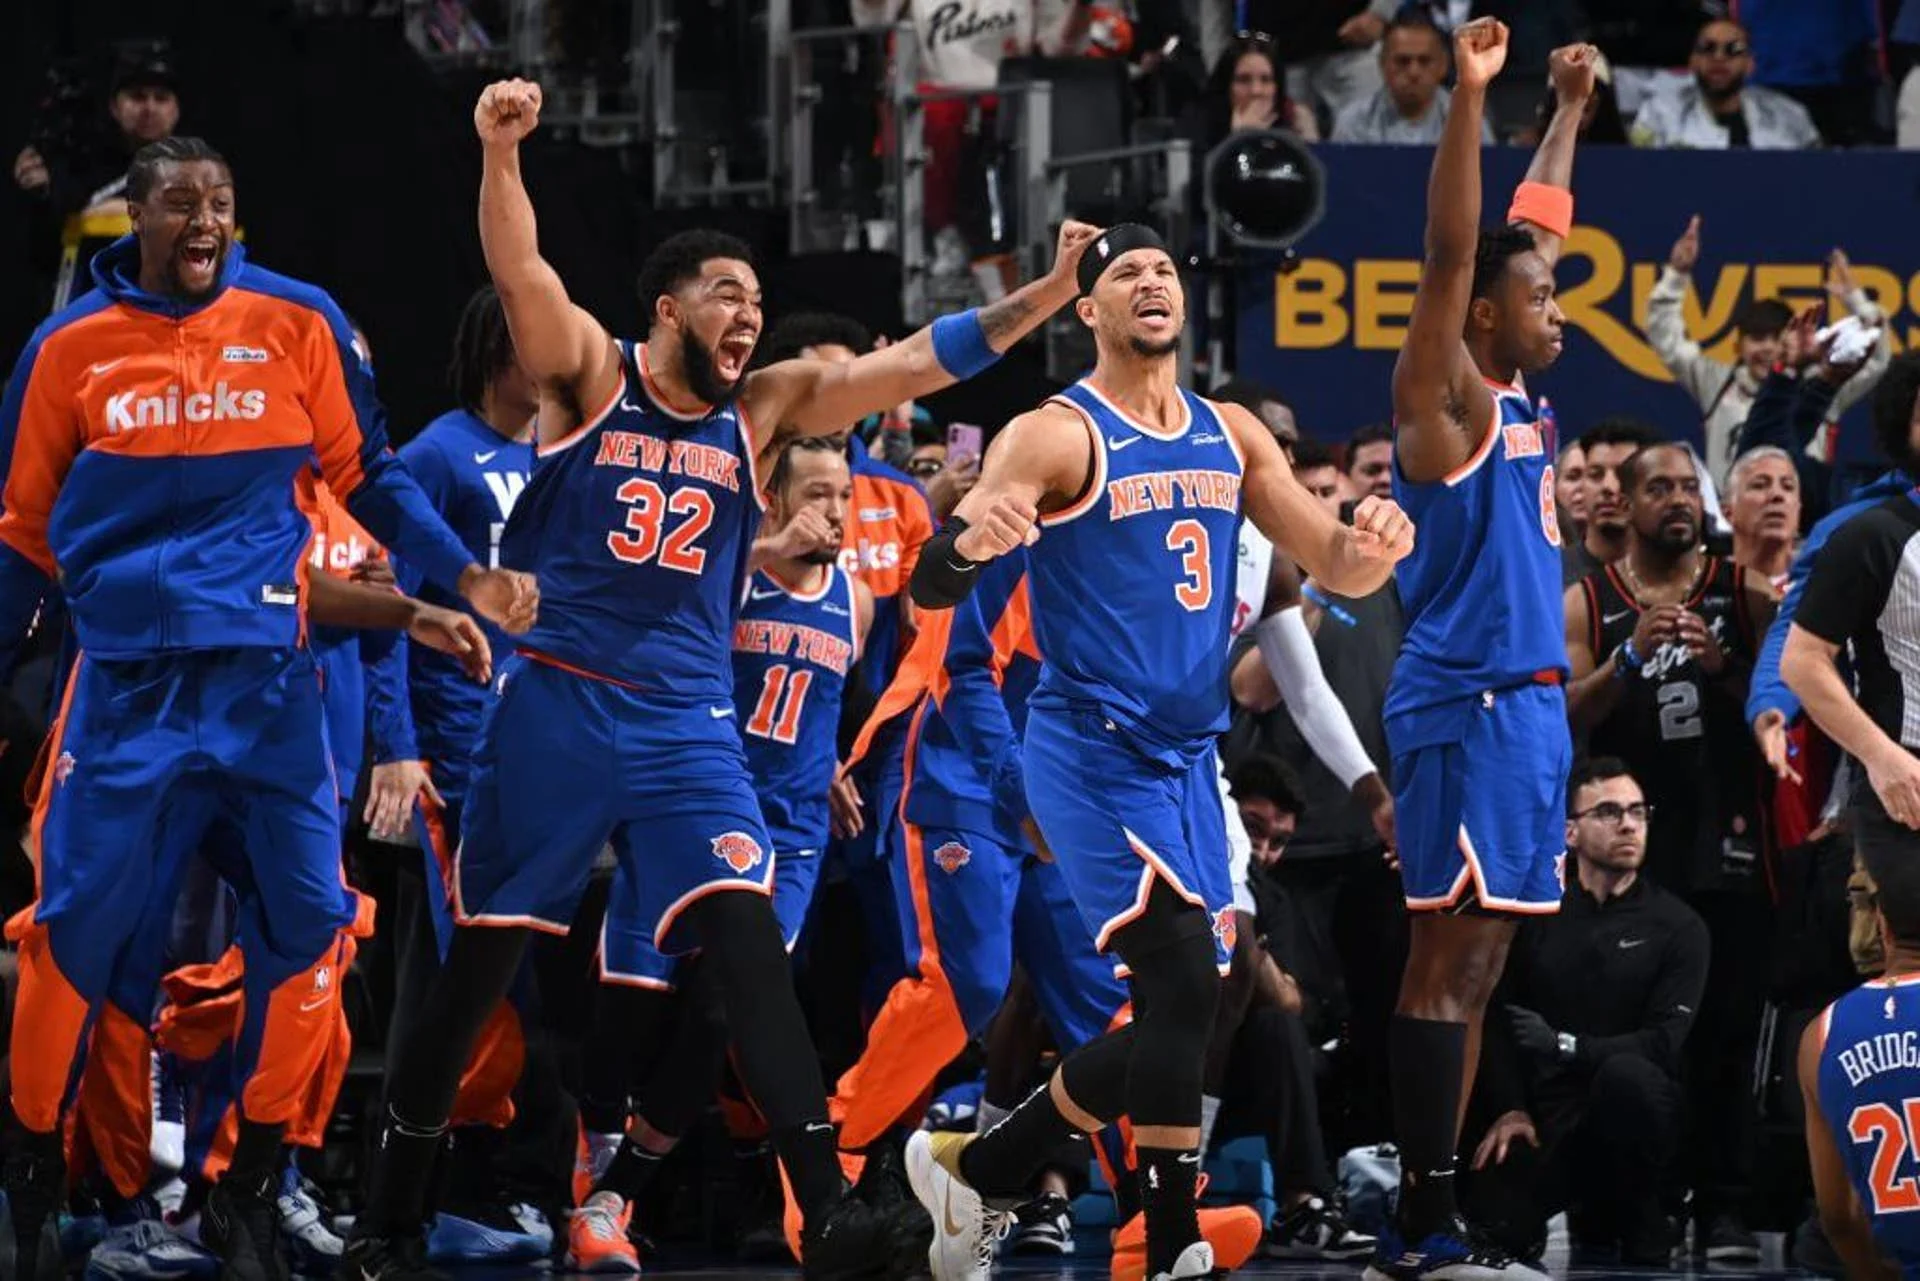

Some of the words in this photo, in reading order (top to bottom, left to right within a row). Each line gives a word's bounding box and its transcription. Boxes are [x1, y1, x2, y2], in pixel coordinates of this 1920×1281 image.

[106, 381, 266, 434] Knicks
[594, 430, 669, 473] NEW
[667, 440, 741, 493] YORK
[607, 477, 715, 574] 32
[1108, 471, 1173, 522] NEW
[1166, 519, 1212, 612] 3
[732, 619, 796, 655] NEW
[789, 624, 852, 678] YORK
[746, 664, 813, 745] 11
[1657, 681, 1704, 740] 2
[1838, 1031, 1920, 1087] BRIDG
